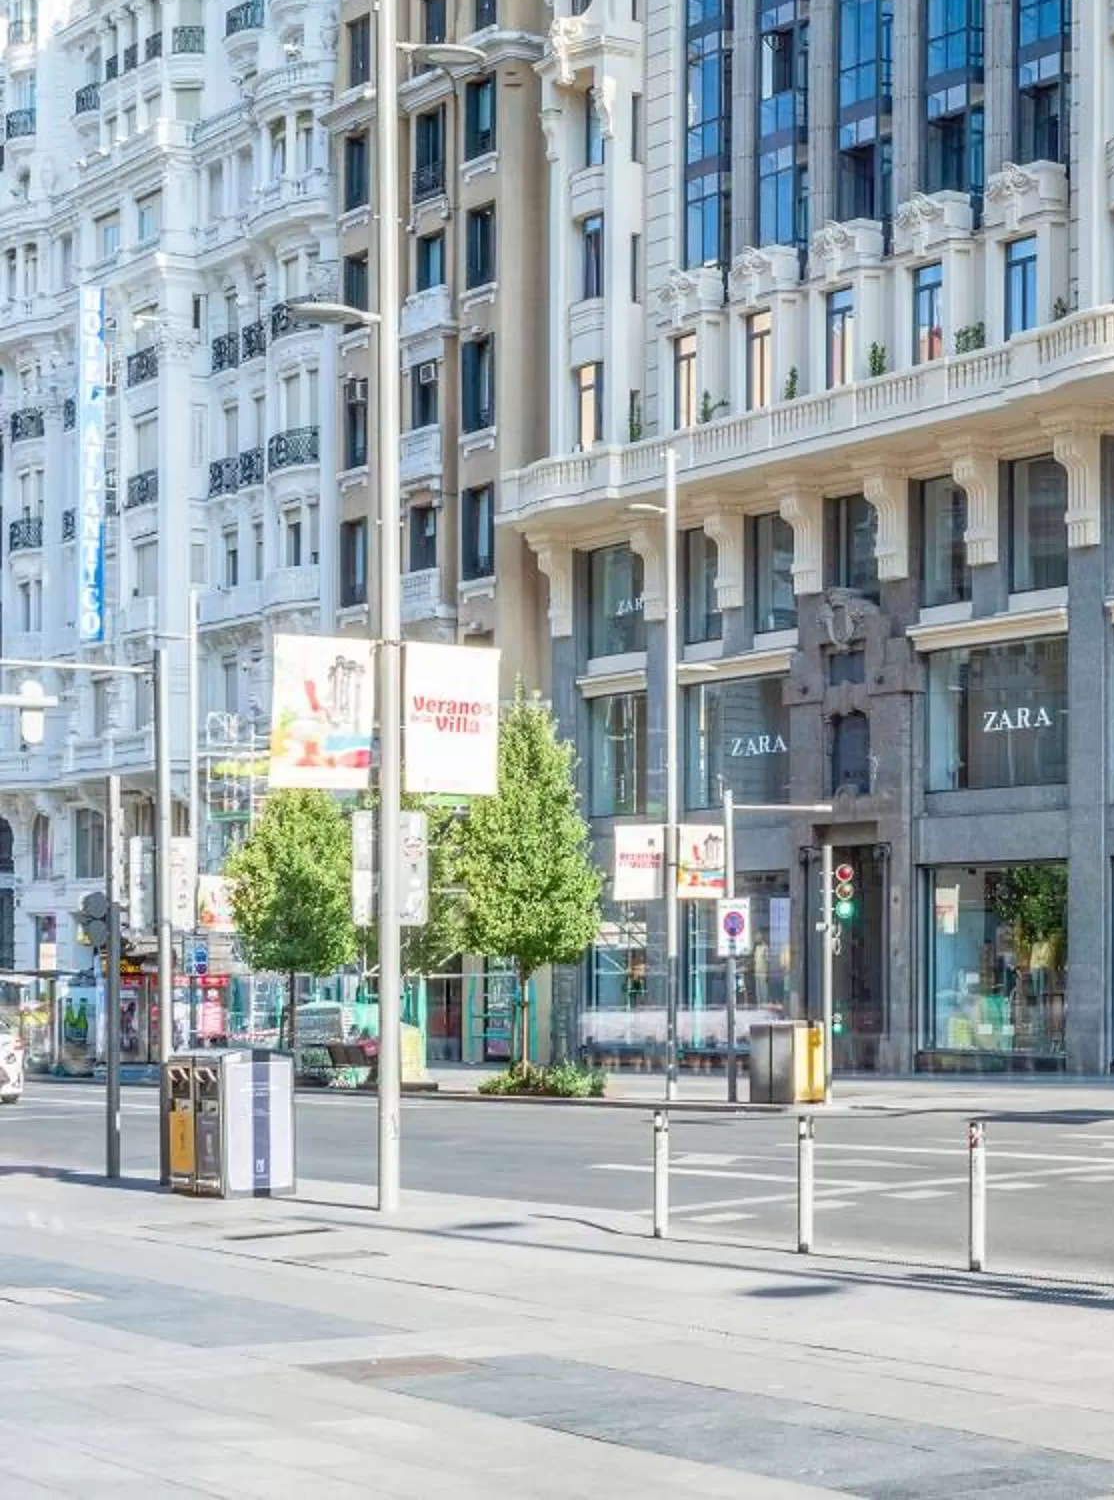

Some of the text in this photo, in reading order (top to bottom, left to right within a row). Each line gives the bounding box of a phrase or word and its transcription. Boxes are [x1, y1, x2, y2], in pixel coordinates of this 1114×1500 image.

[82, 286, 102, 404] HOTEL
[616, 597, 643, 616] ZAR
[413, 694, 493, 716] Veranos
[435, 715, 481, 733] Villa
[983, 706, 1053, 732] ZARA
[731, 735, 788, 757] ZARA
